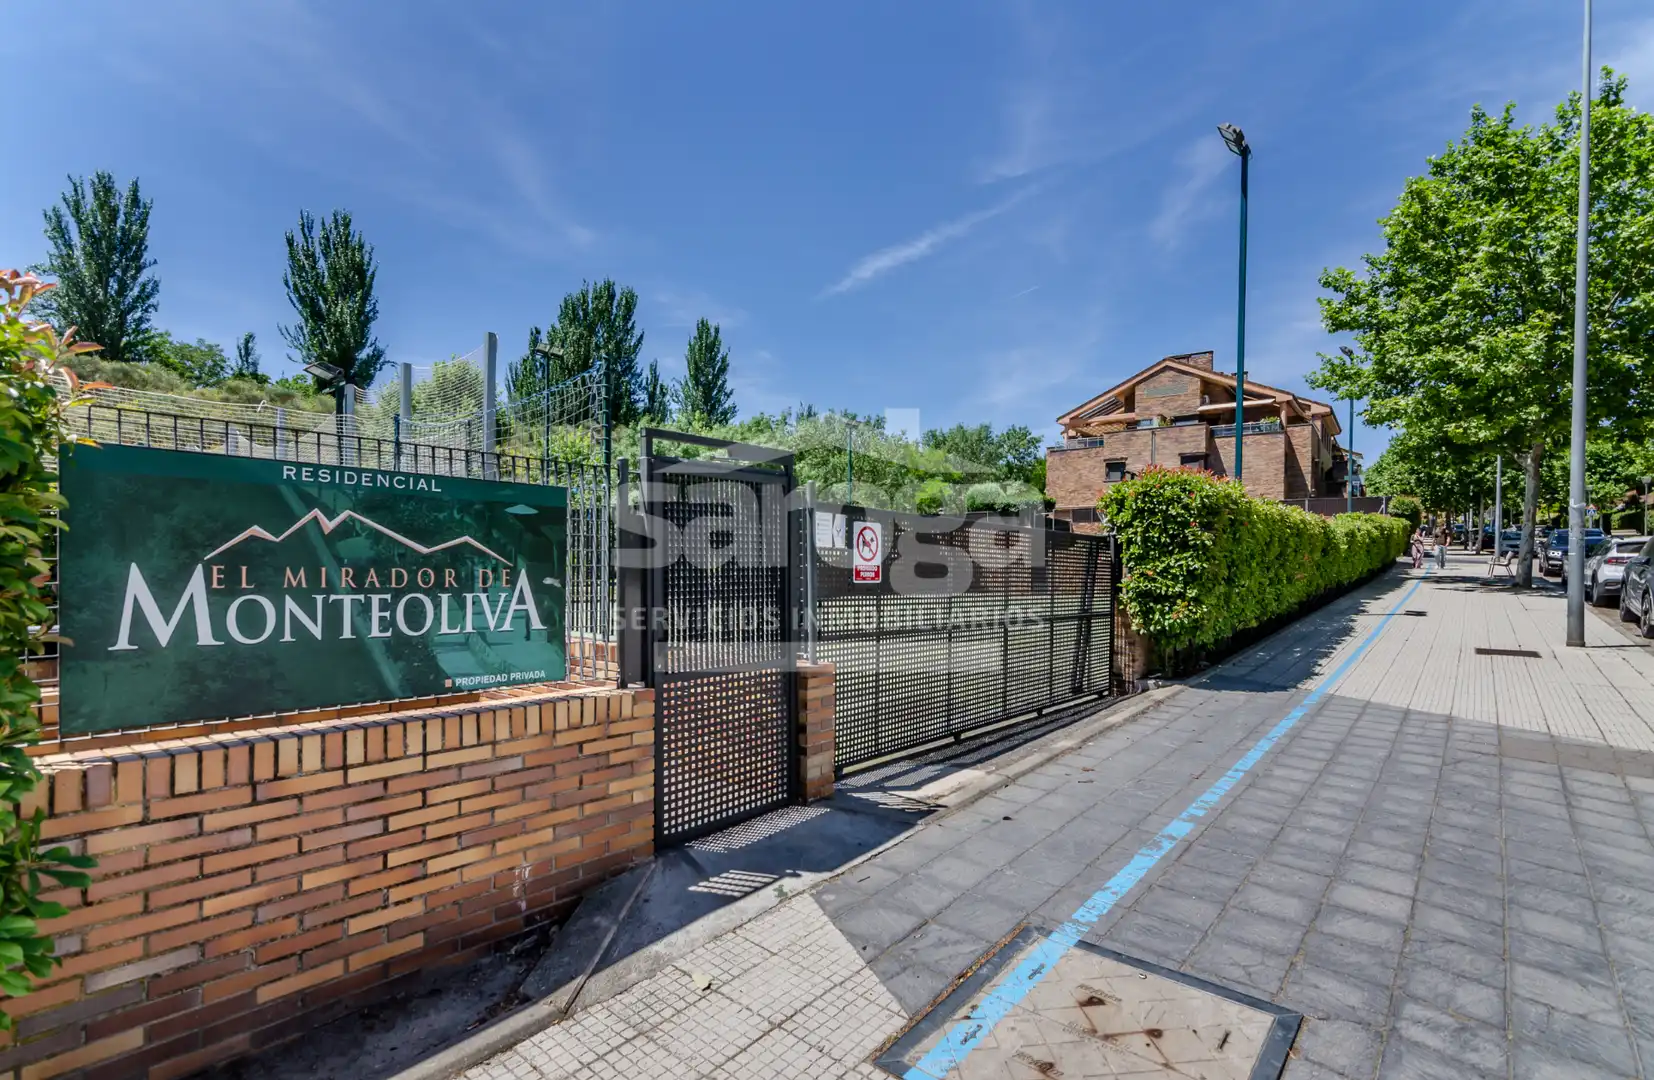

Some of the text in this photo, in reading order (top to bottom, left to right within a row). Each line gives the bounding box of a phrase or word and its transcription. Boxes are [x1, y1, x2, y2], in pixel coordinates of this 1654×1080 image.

[282, 465, 442, 492] RESIDENCIAL
[211, 565, 511, 589] EL MIRADOR DE
[108, 562, 547, 651] MONTEOLIVA
[455, 670, 546, 687] PROPIEDAD PRIVADA
